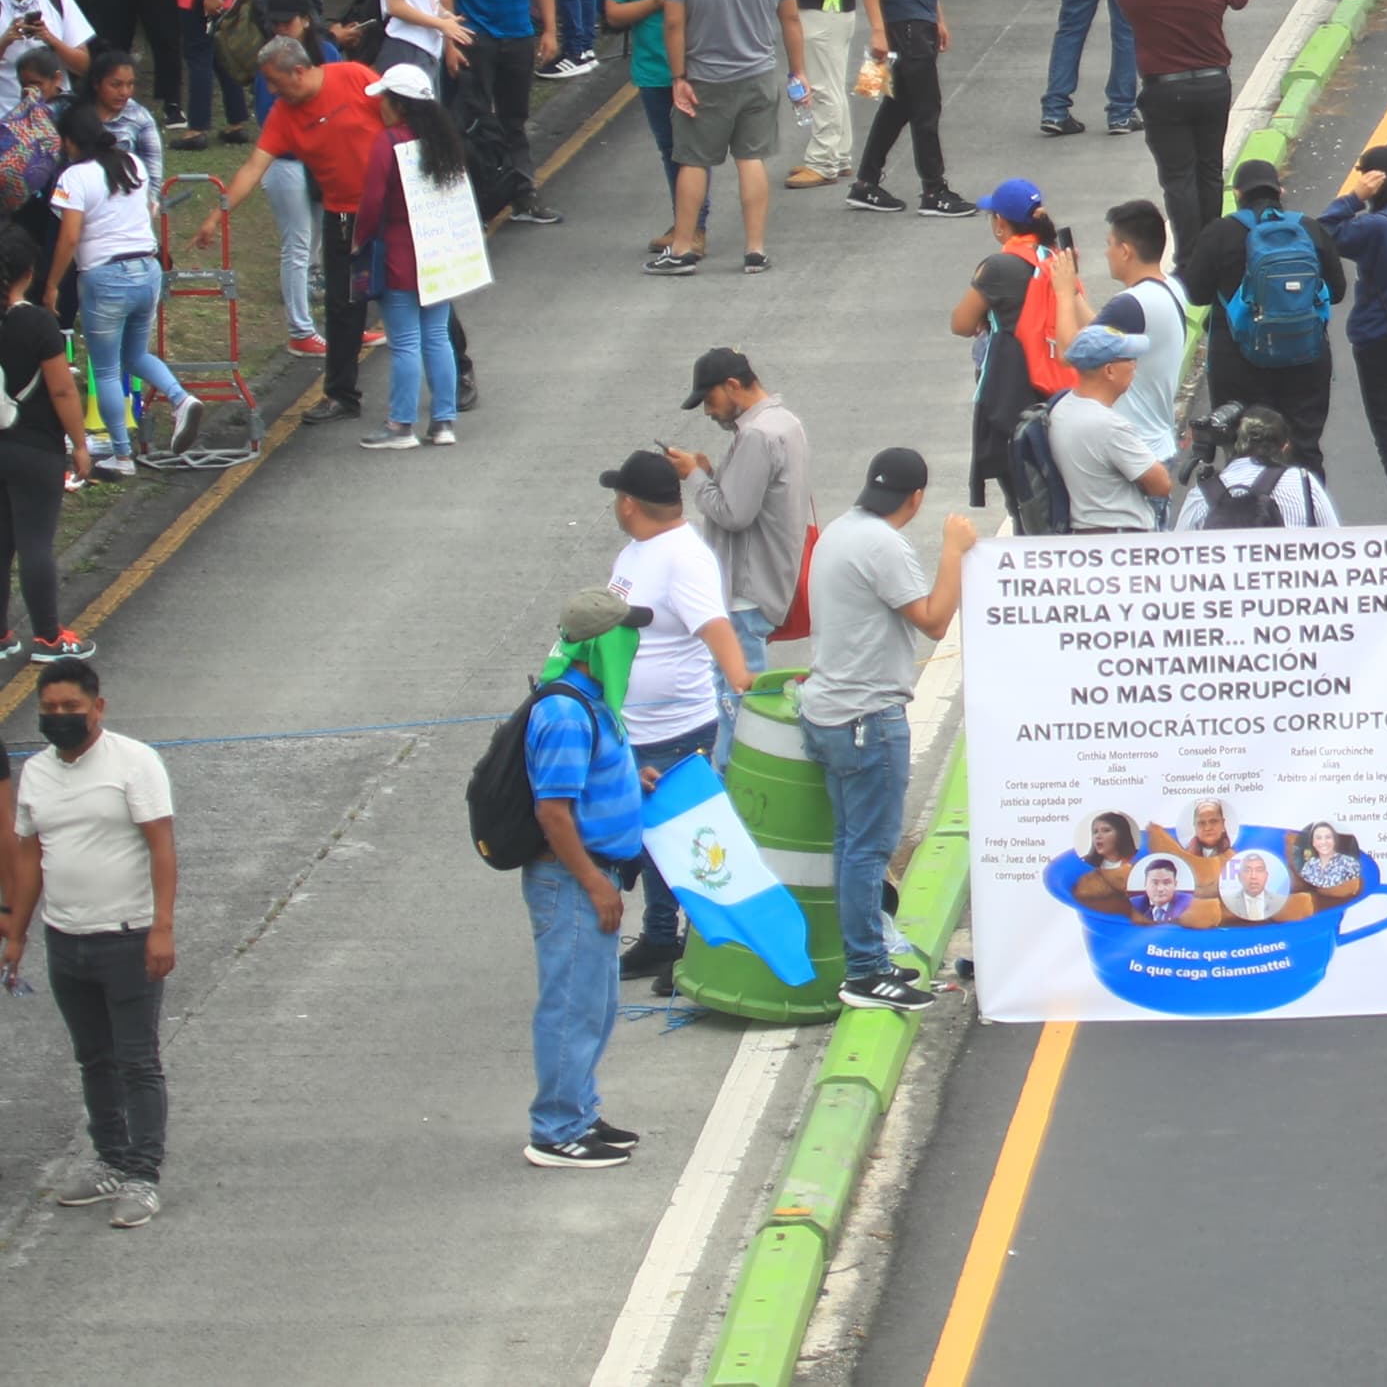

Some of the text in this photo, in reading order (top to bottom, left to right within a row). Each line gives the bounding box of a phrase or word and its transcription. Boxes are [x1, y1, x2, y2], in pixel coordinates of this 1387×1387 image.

[998, 552, 1015, 570] A
[1023, 549, 1103, 569] ESTOS
[1111, 545, 1226, 567] CEROTES
[1233, 541, 1356, 563] TENEMOS
[998, 576, 1121, 597] TIRARLOS
[1129, 574, 1161, 594] EN
[1170, 573, 1226, 592] UNA
[1233, 568, 1338, 591] LETRINA
[986, 604, 1111, 625] SELLARLA
[1118, 603, 1134, 622] Y
[1142, 601, 1195, 621] QUE
[1202, 600, 1233, 619] SE
[1241, 596, 1349, 618] PUDRAN
[1059, 623, 1355, 651] PROPIA MIER... NO MAS
[1097, 647, 1318, 677] CONTAMINACIÓN
[1071, 673, 1351, 706] NO MAS CORRUPCIÓN
[1016, 714, 1266, 742] ANTIDEMOCRÁTICOS
[1146, 940, 1287, 962] Bacinica que contiene
[1129, 957, 1291, 981] lo que caga Giammattei
